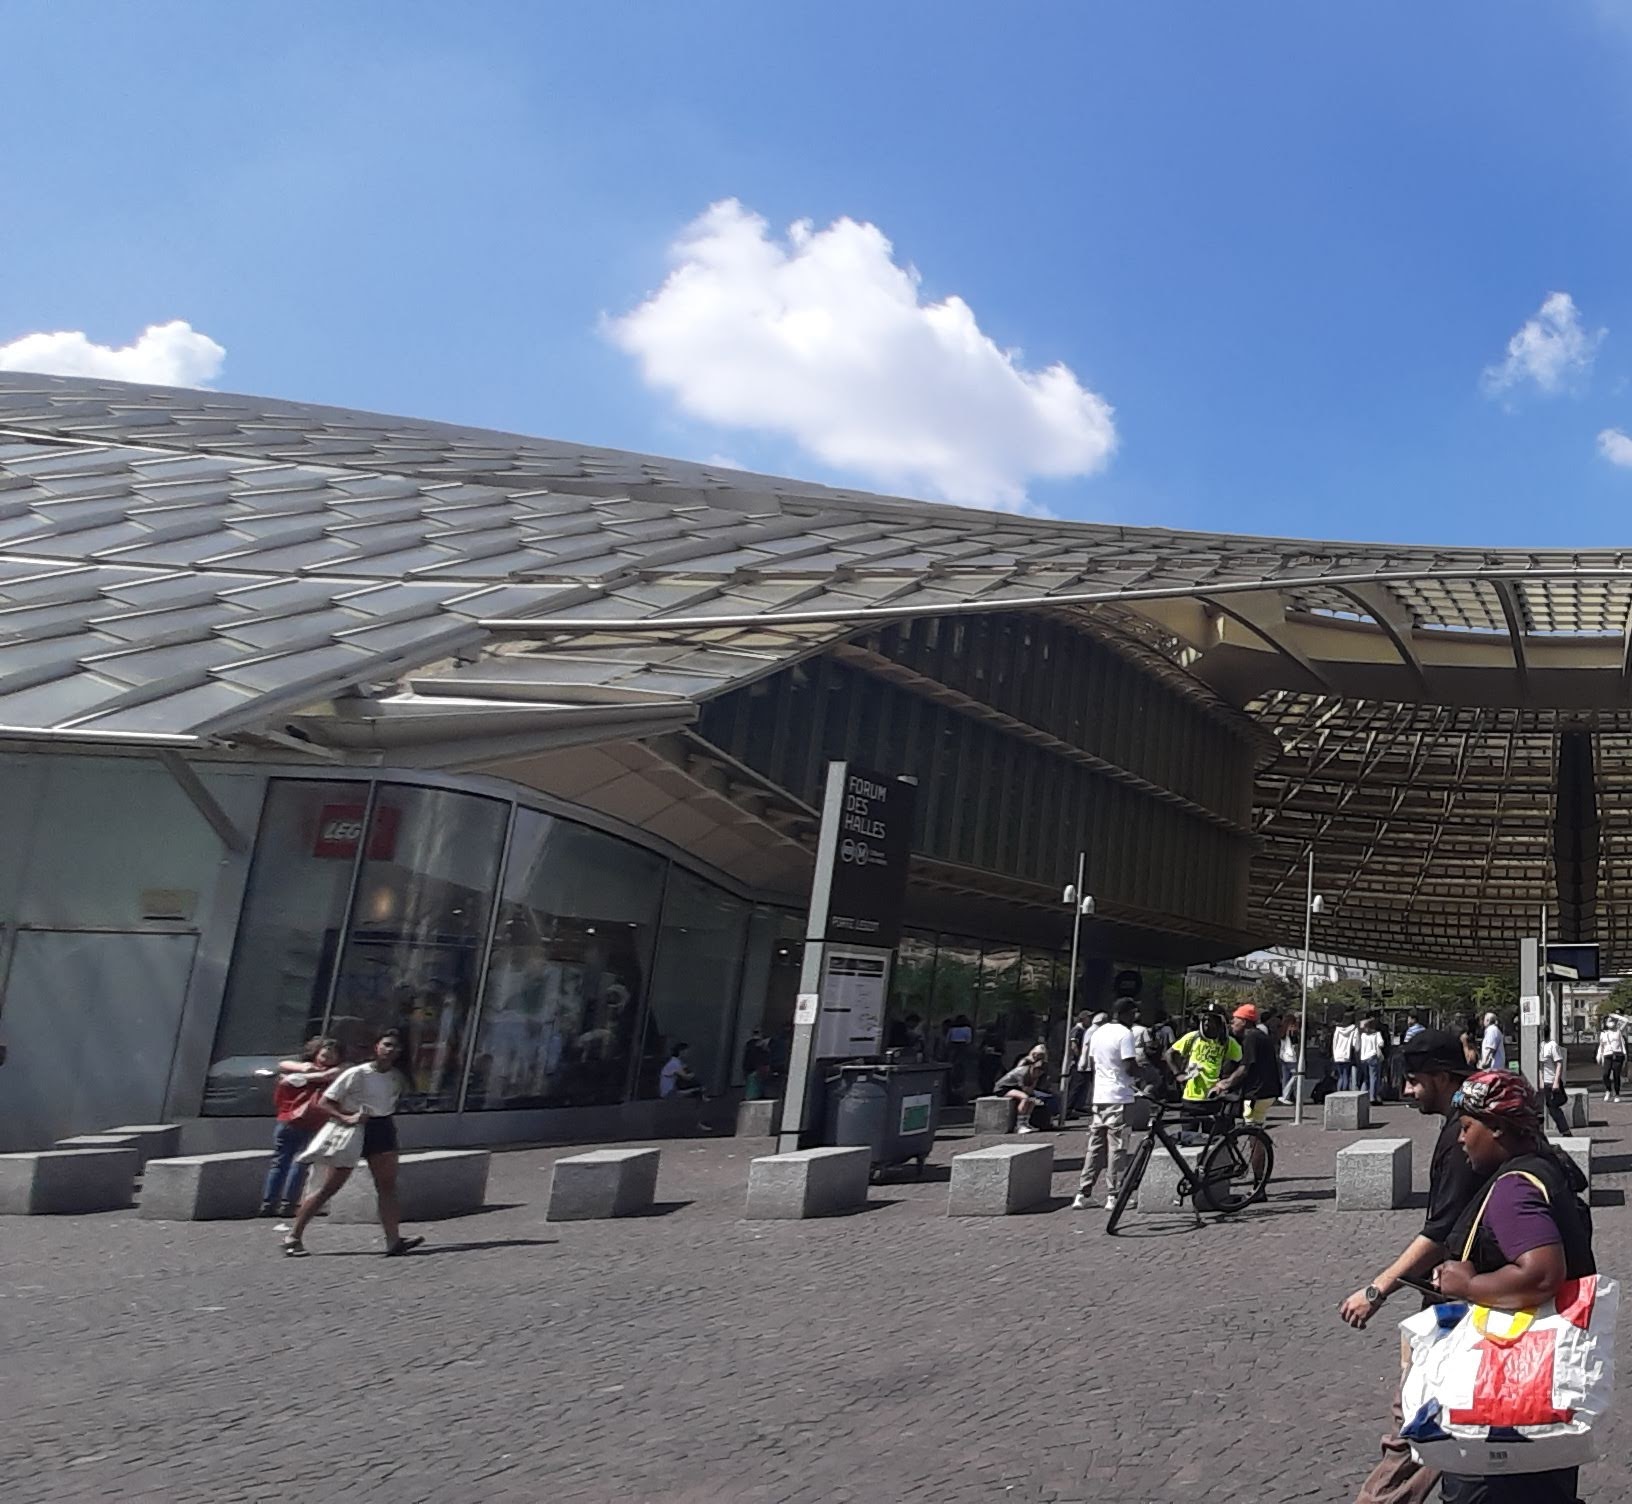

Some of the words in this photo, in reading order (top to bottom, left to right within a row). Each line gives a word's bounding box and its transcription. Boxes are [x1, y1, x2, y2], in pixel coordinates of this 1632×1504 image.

[849, 775, 887, 802] FORUM
[847, 794, 869, 815] DES
[323, 821, 363, 840] LEG
[844, 812, 886, 839] HALLES
